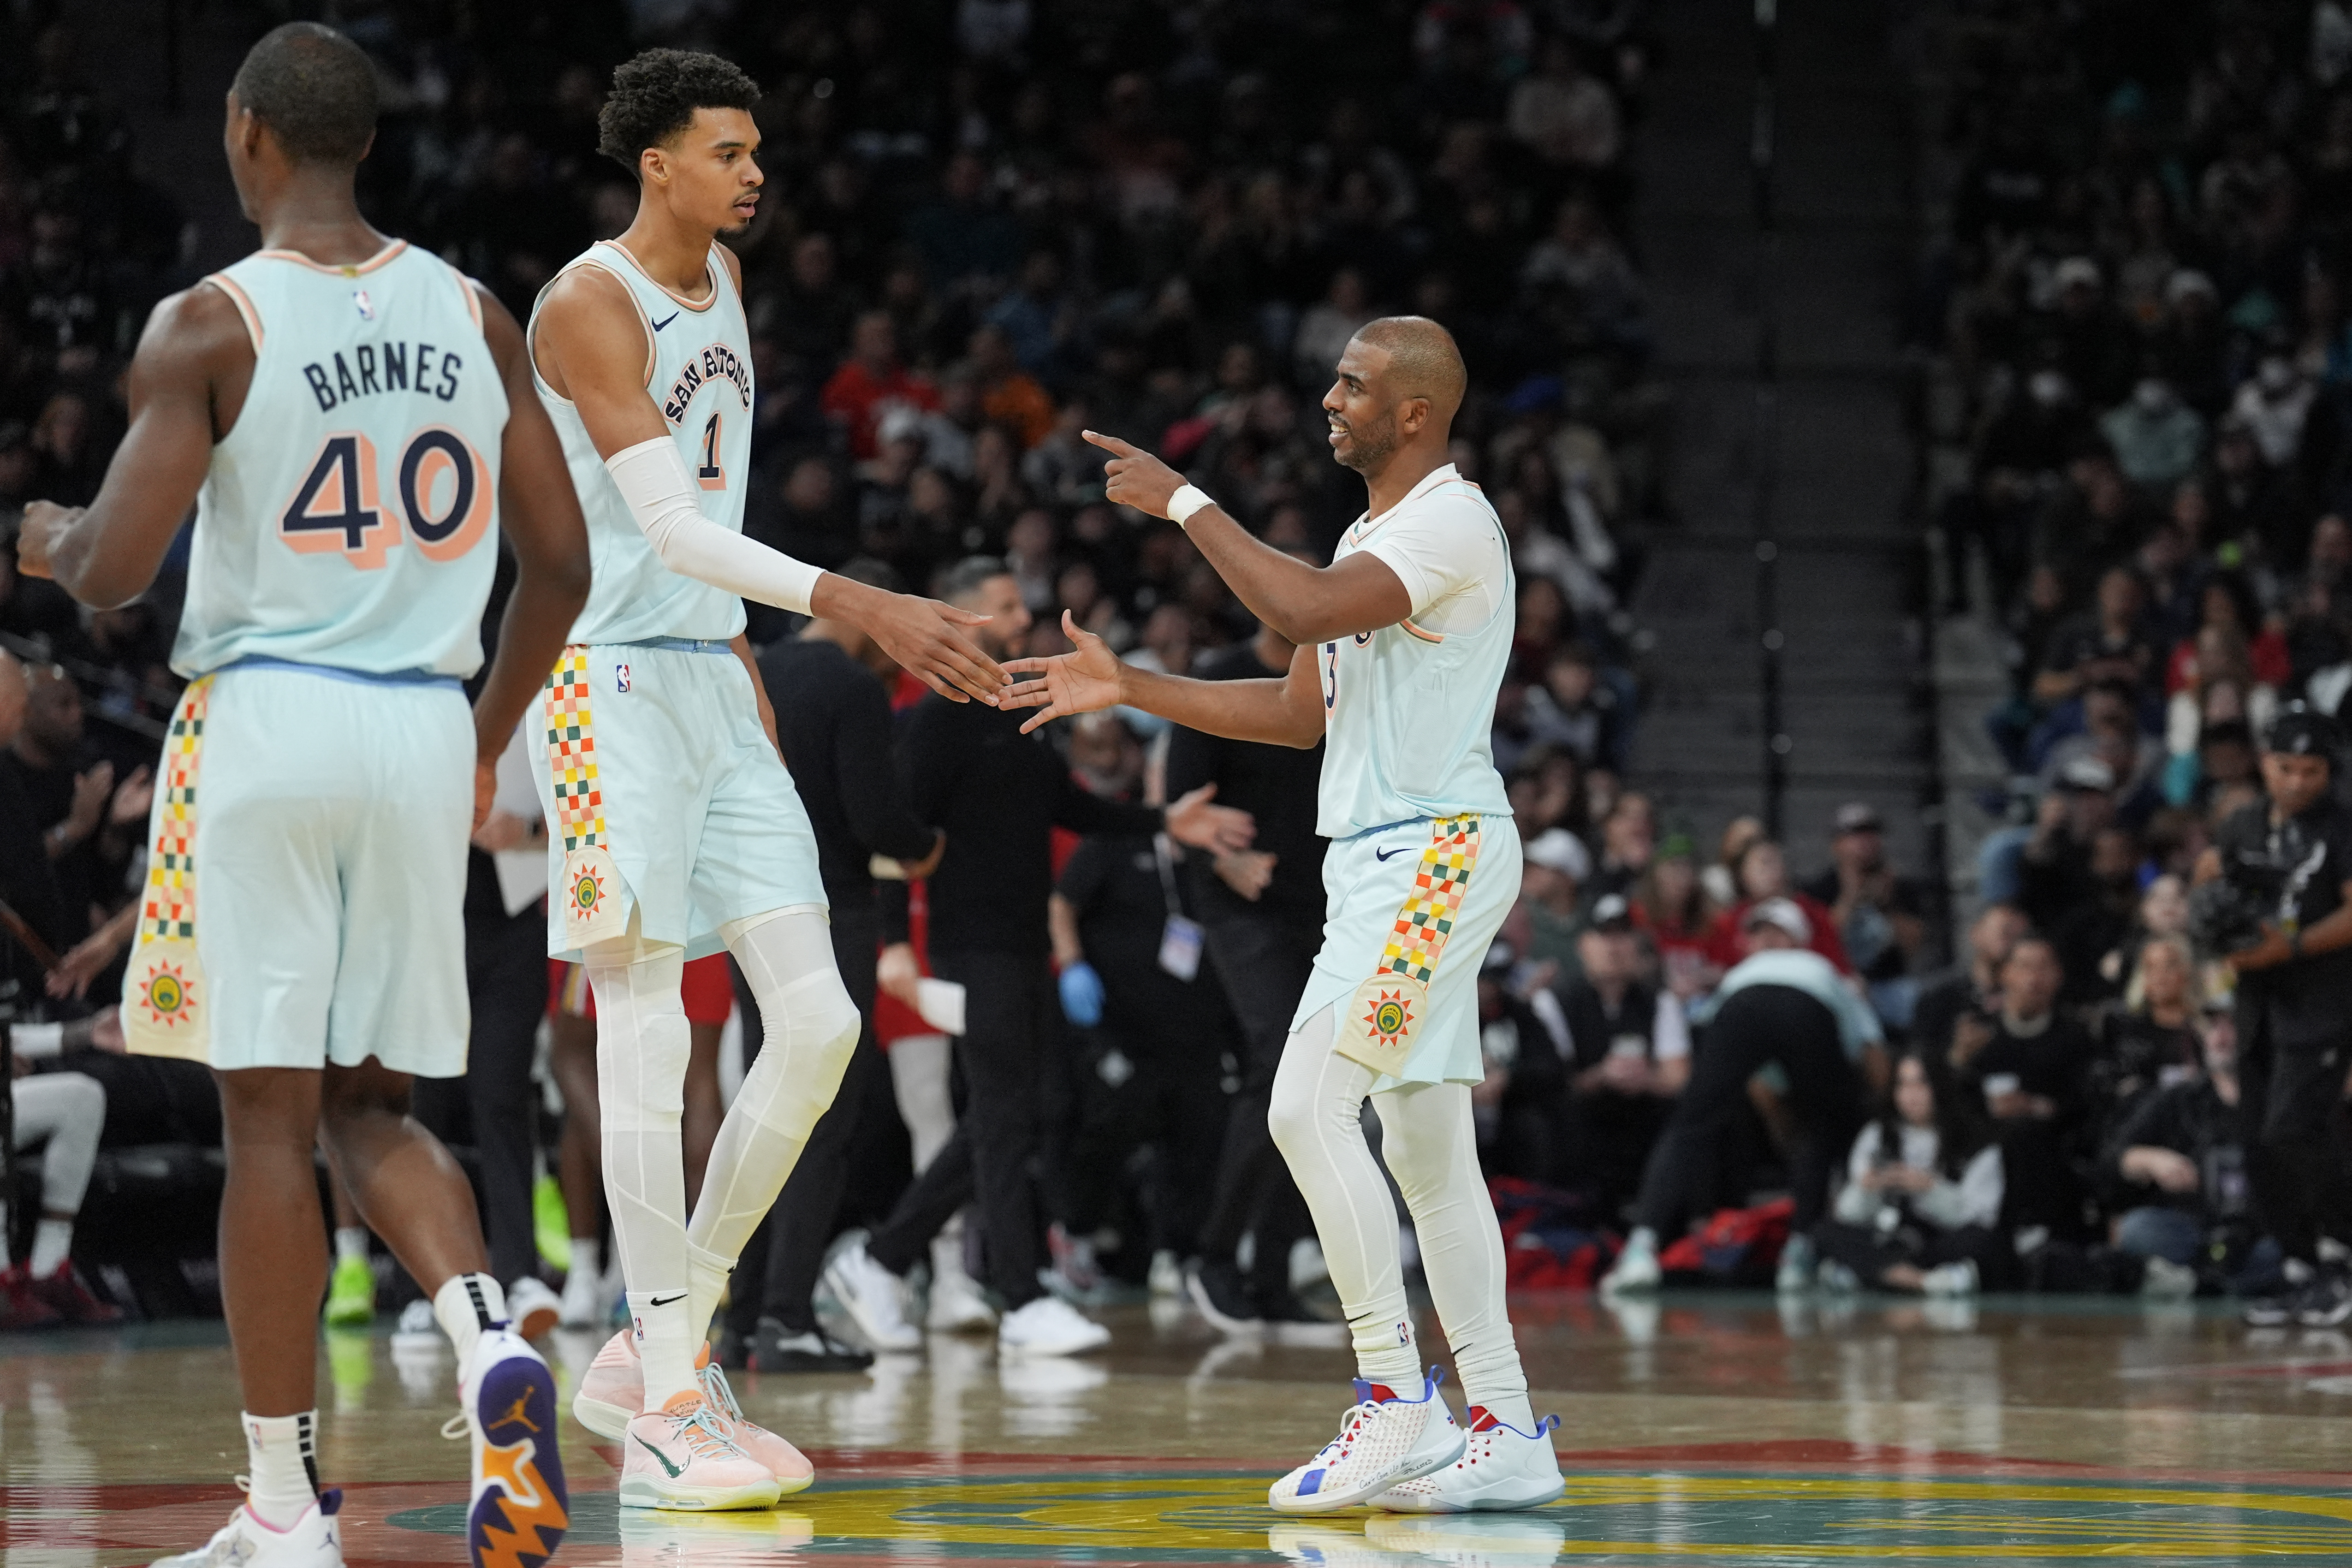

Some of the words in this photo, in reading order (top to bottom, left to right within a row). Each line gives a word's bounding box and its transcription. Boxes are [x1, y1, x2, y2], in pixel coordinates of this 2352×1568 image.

[303, 342, 462, 412] BARNES
[665, 361, 702, 424] SAN
[698, 412, 722, 482] 1
[280, 428, 482, 557] 40
